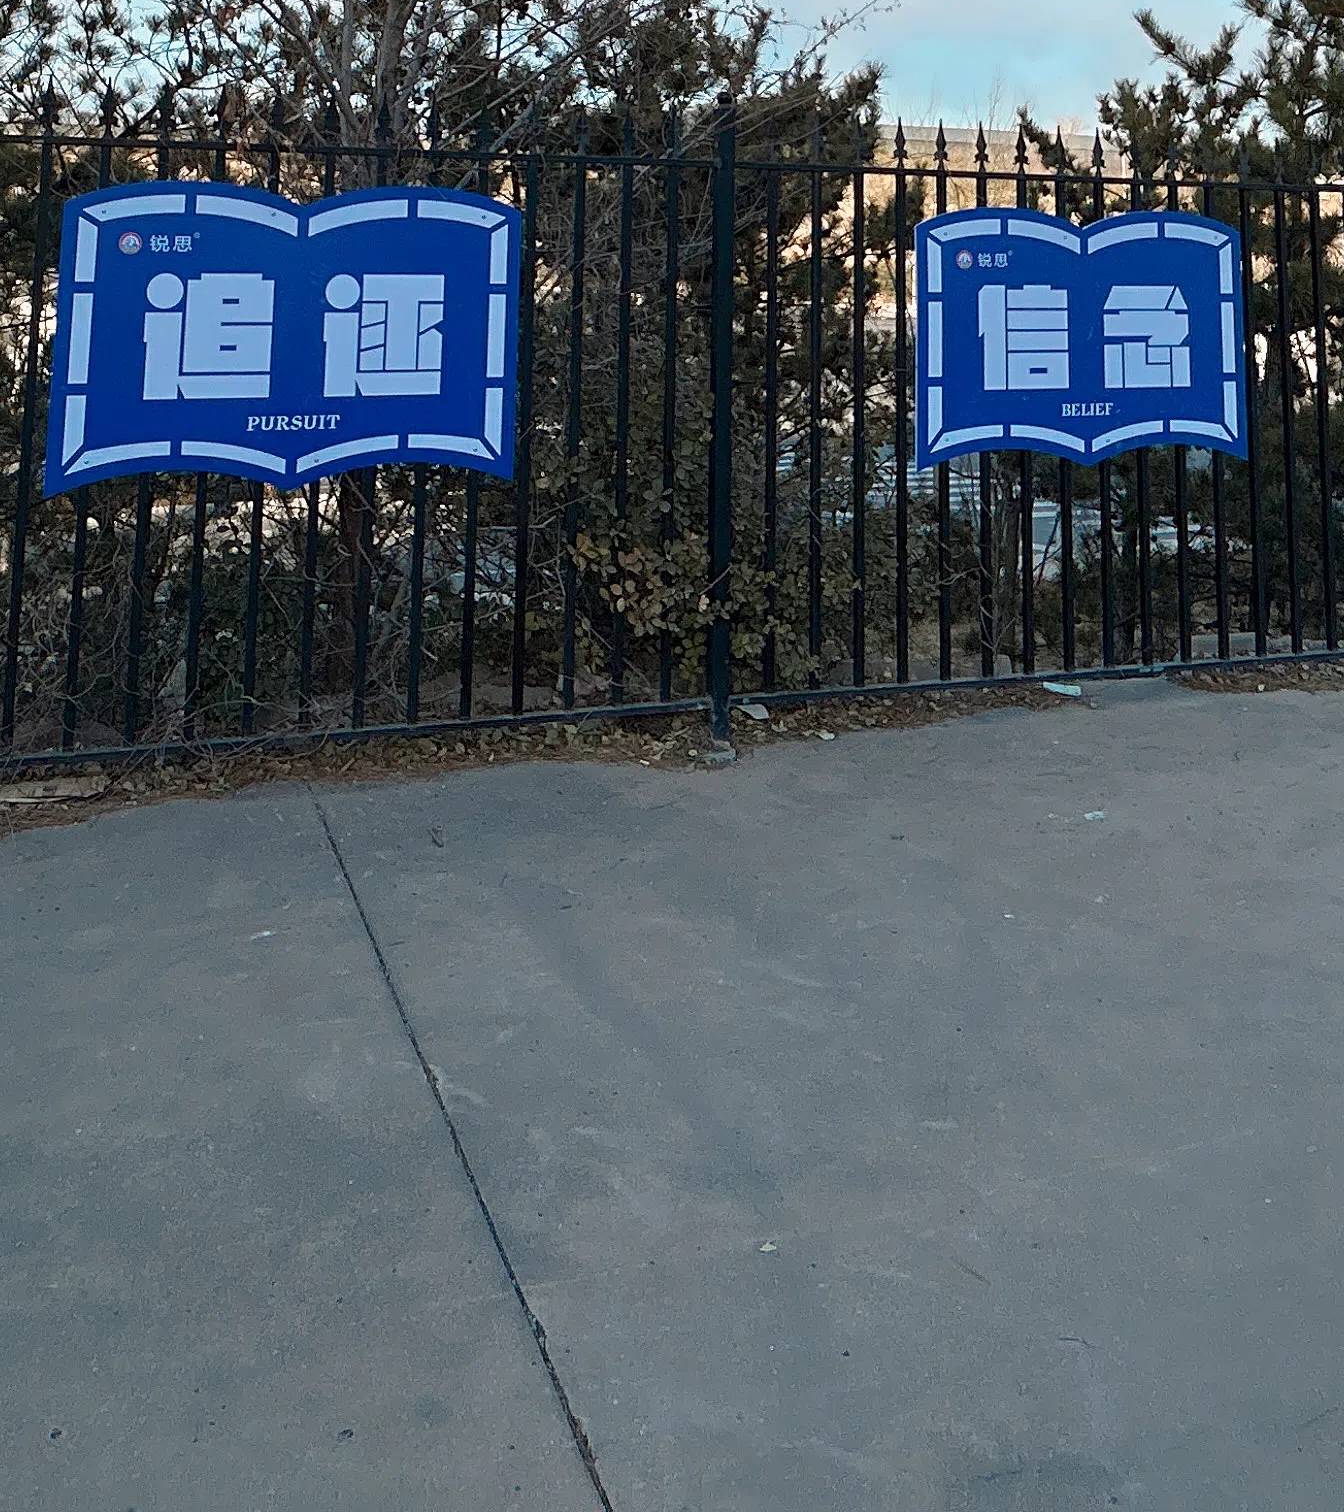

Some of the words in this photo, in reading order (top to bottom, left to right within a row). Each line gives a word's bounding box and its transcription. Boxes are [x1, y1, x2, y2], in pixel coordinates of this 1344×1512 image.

[149, 234, 193, 253] 锐思
[142, 272, 445, 401] 追逐
[978, 284, 1191, 391] 信念
[1061, 403, 1114, 417] BELIEF
[246, 413, 341, 432] PURSUIT
